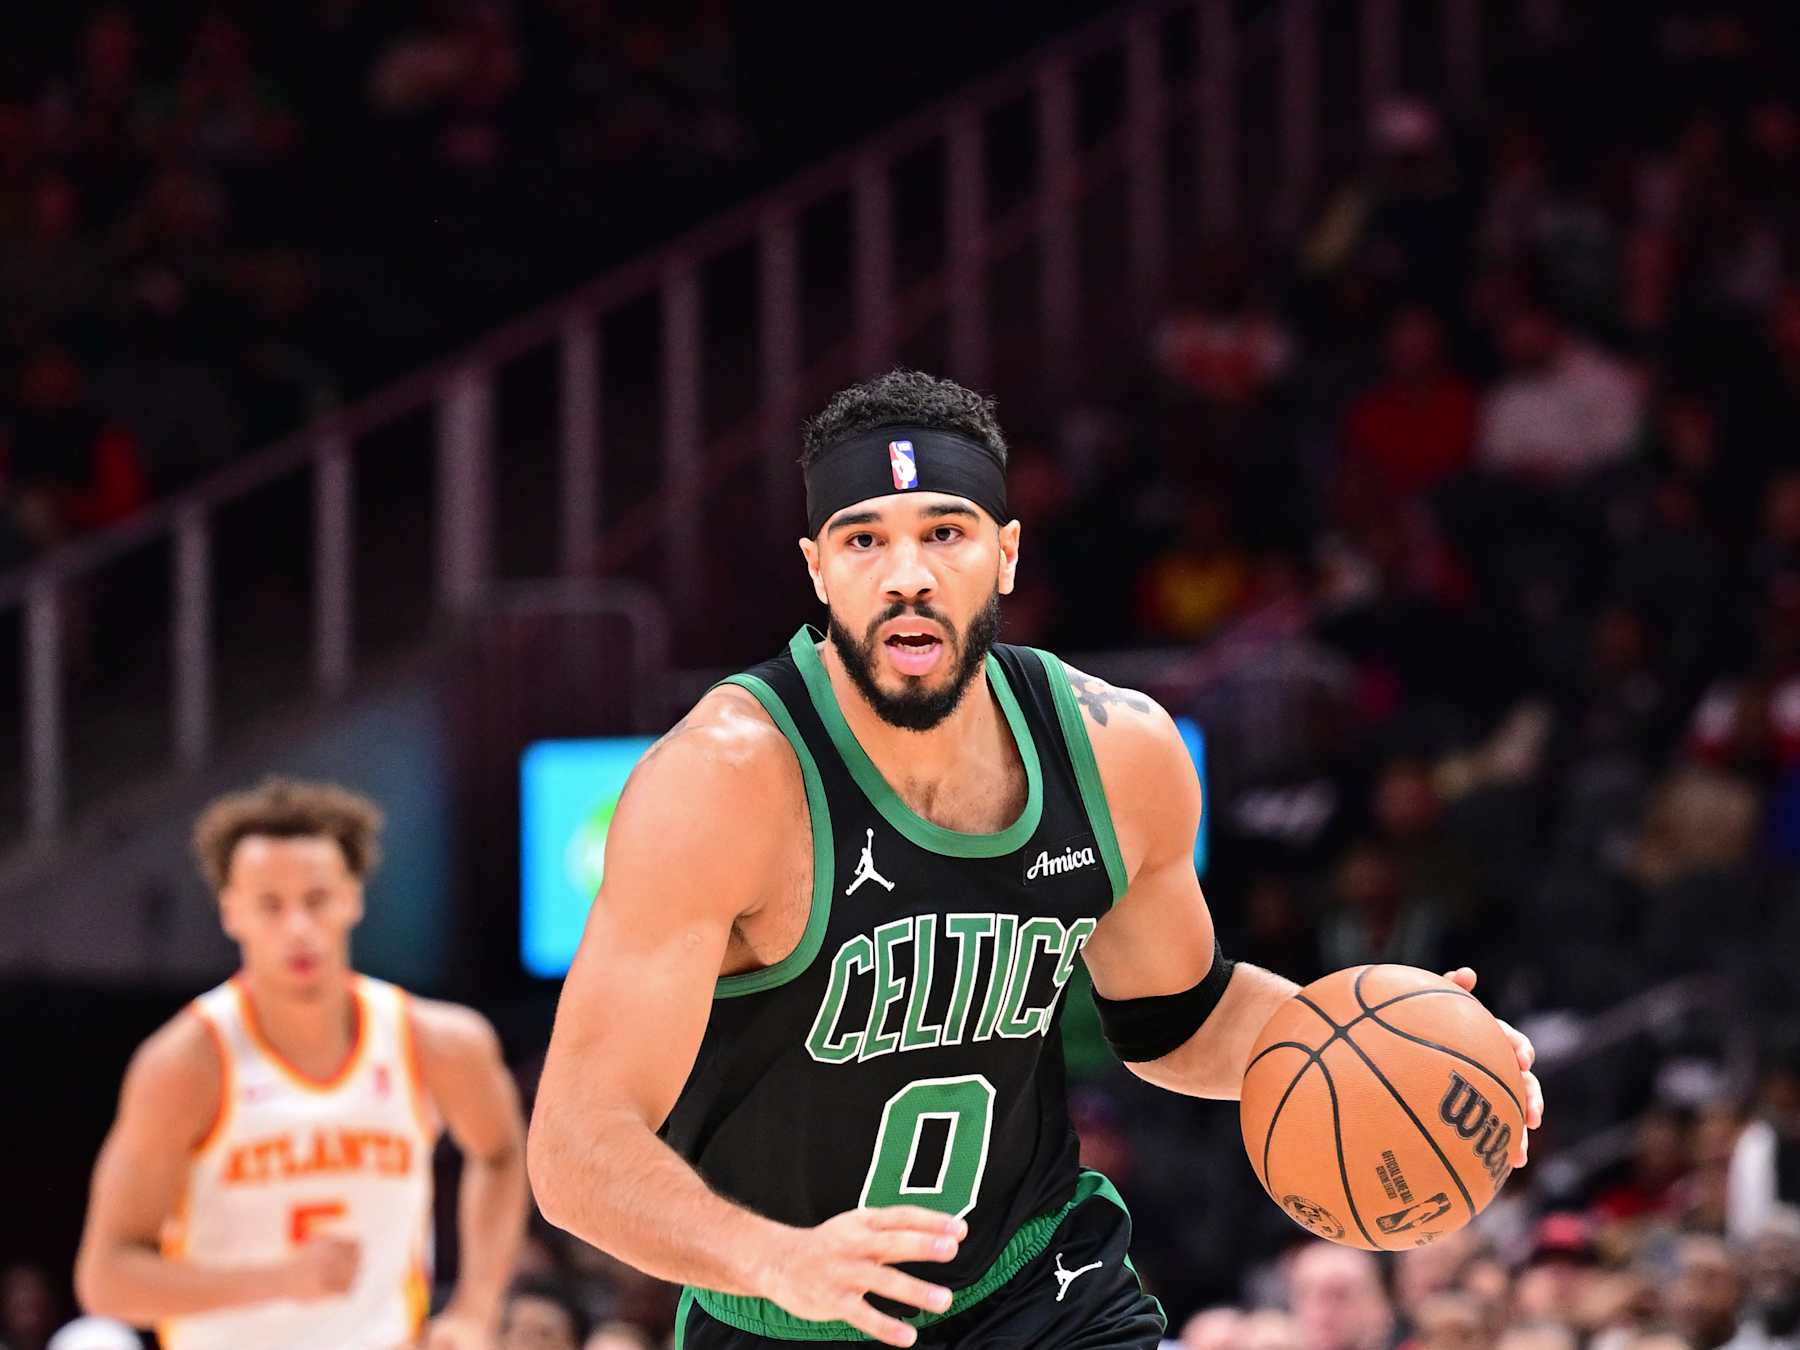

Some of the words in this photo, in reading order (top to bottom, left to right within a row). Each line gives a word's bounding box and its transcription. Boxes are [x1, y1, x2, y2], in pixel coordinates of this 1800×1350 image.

[1026, 846, 1096, 880] Amica
[859, 1073, 997, 1221] 0
[1440, 1069, 1512, 1196] Wil
